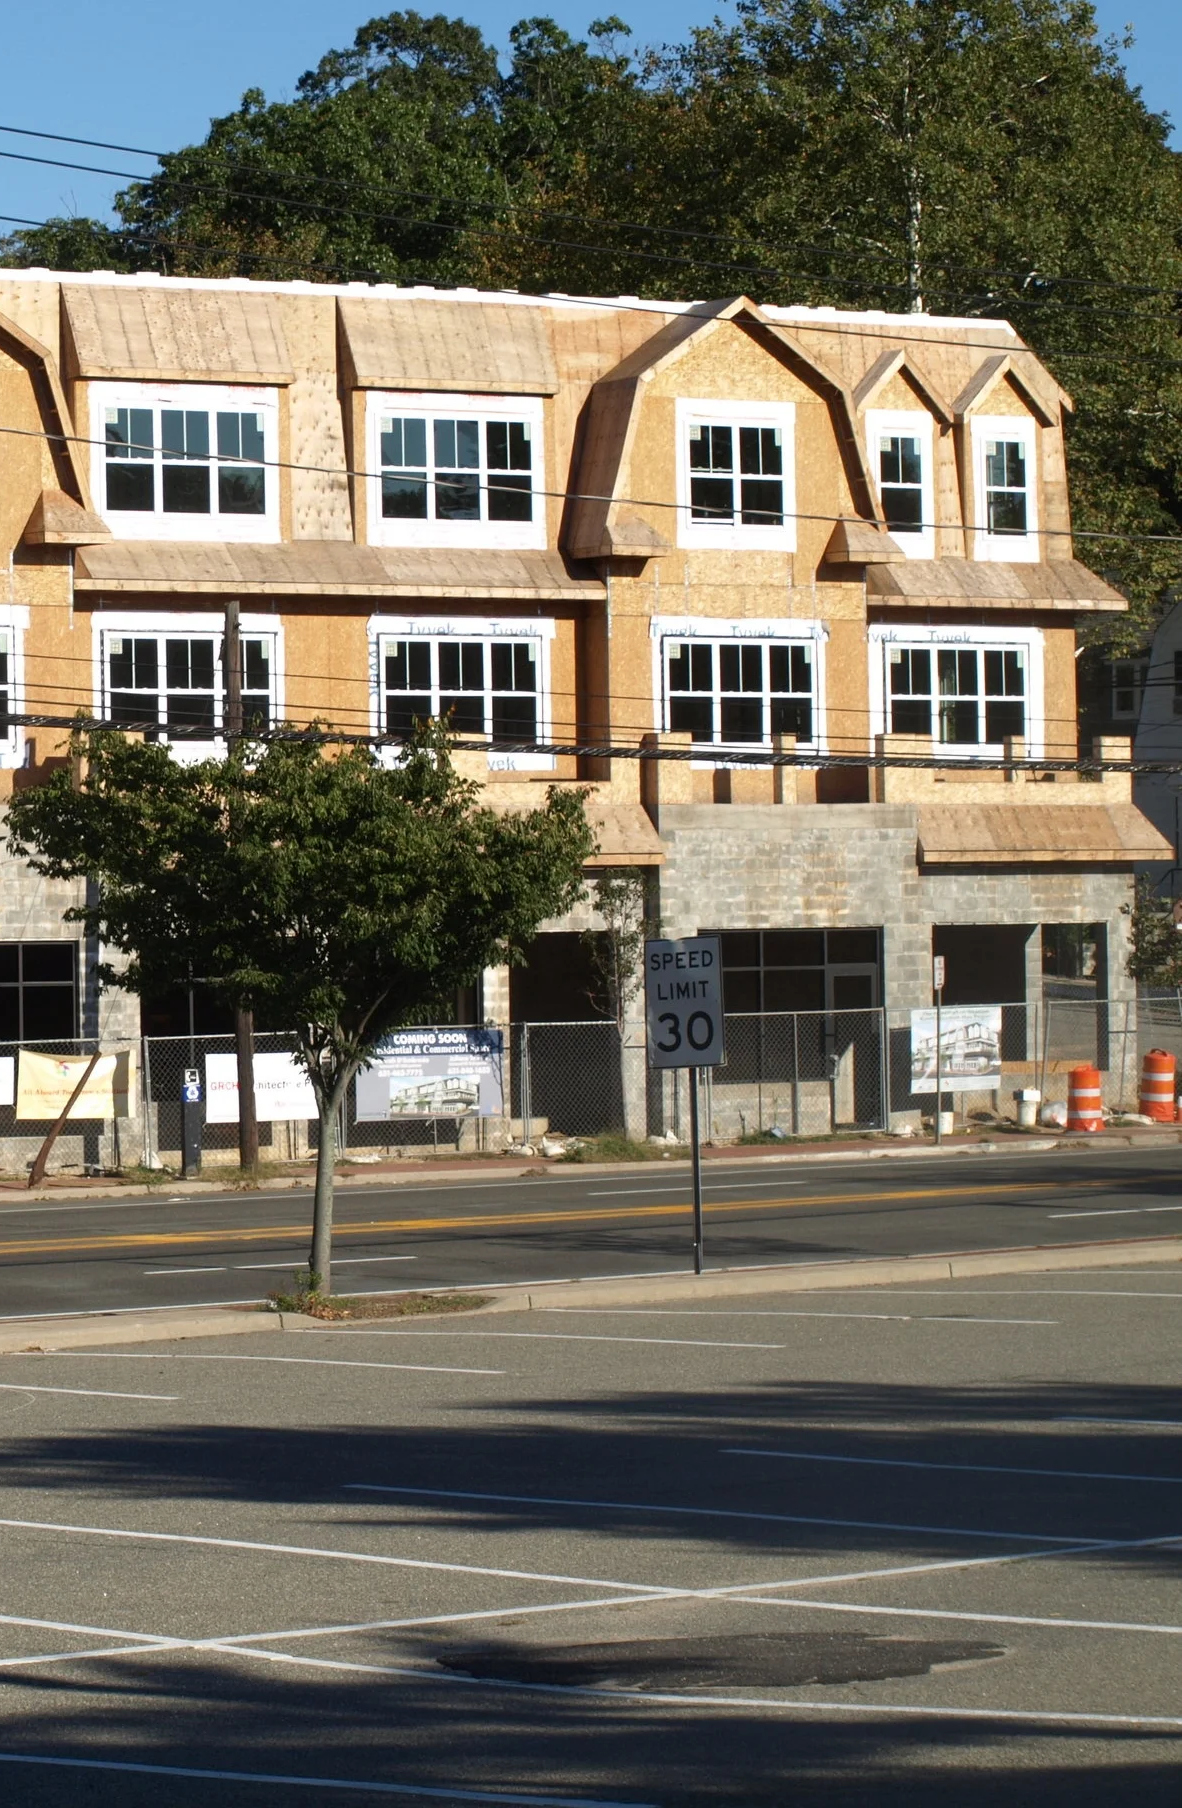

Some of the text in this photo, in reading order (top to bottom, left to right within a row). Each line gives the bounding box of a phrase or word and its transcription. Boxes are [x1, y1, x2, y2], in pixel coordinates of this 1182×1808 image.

[487, 756, 517, 771] vek
[651, 950, 713, 971] SPEED
[657, 981, 709, 1000] LIMIT
[393, 1033, 467, 1045] COMING SOON
[657, 1011, 714, 1052] 30
[414, 1045, 421, 1054] &
